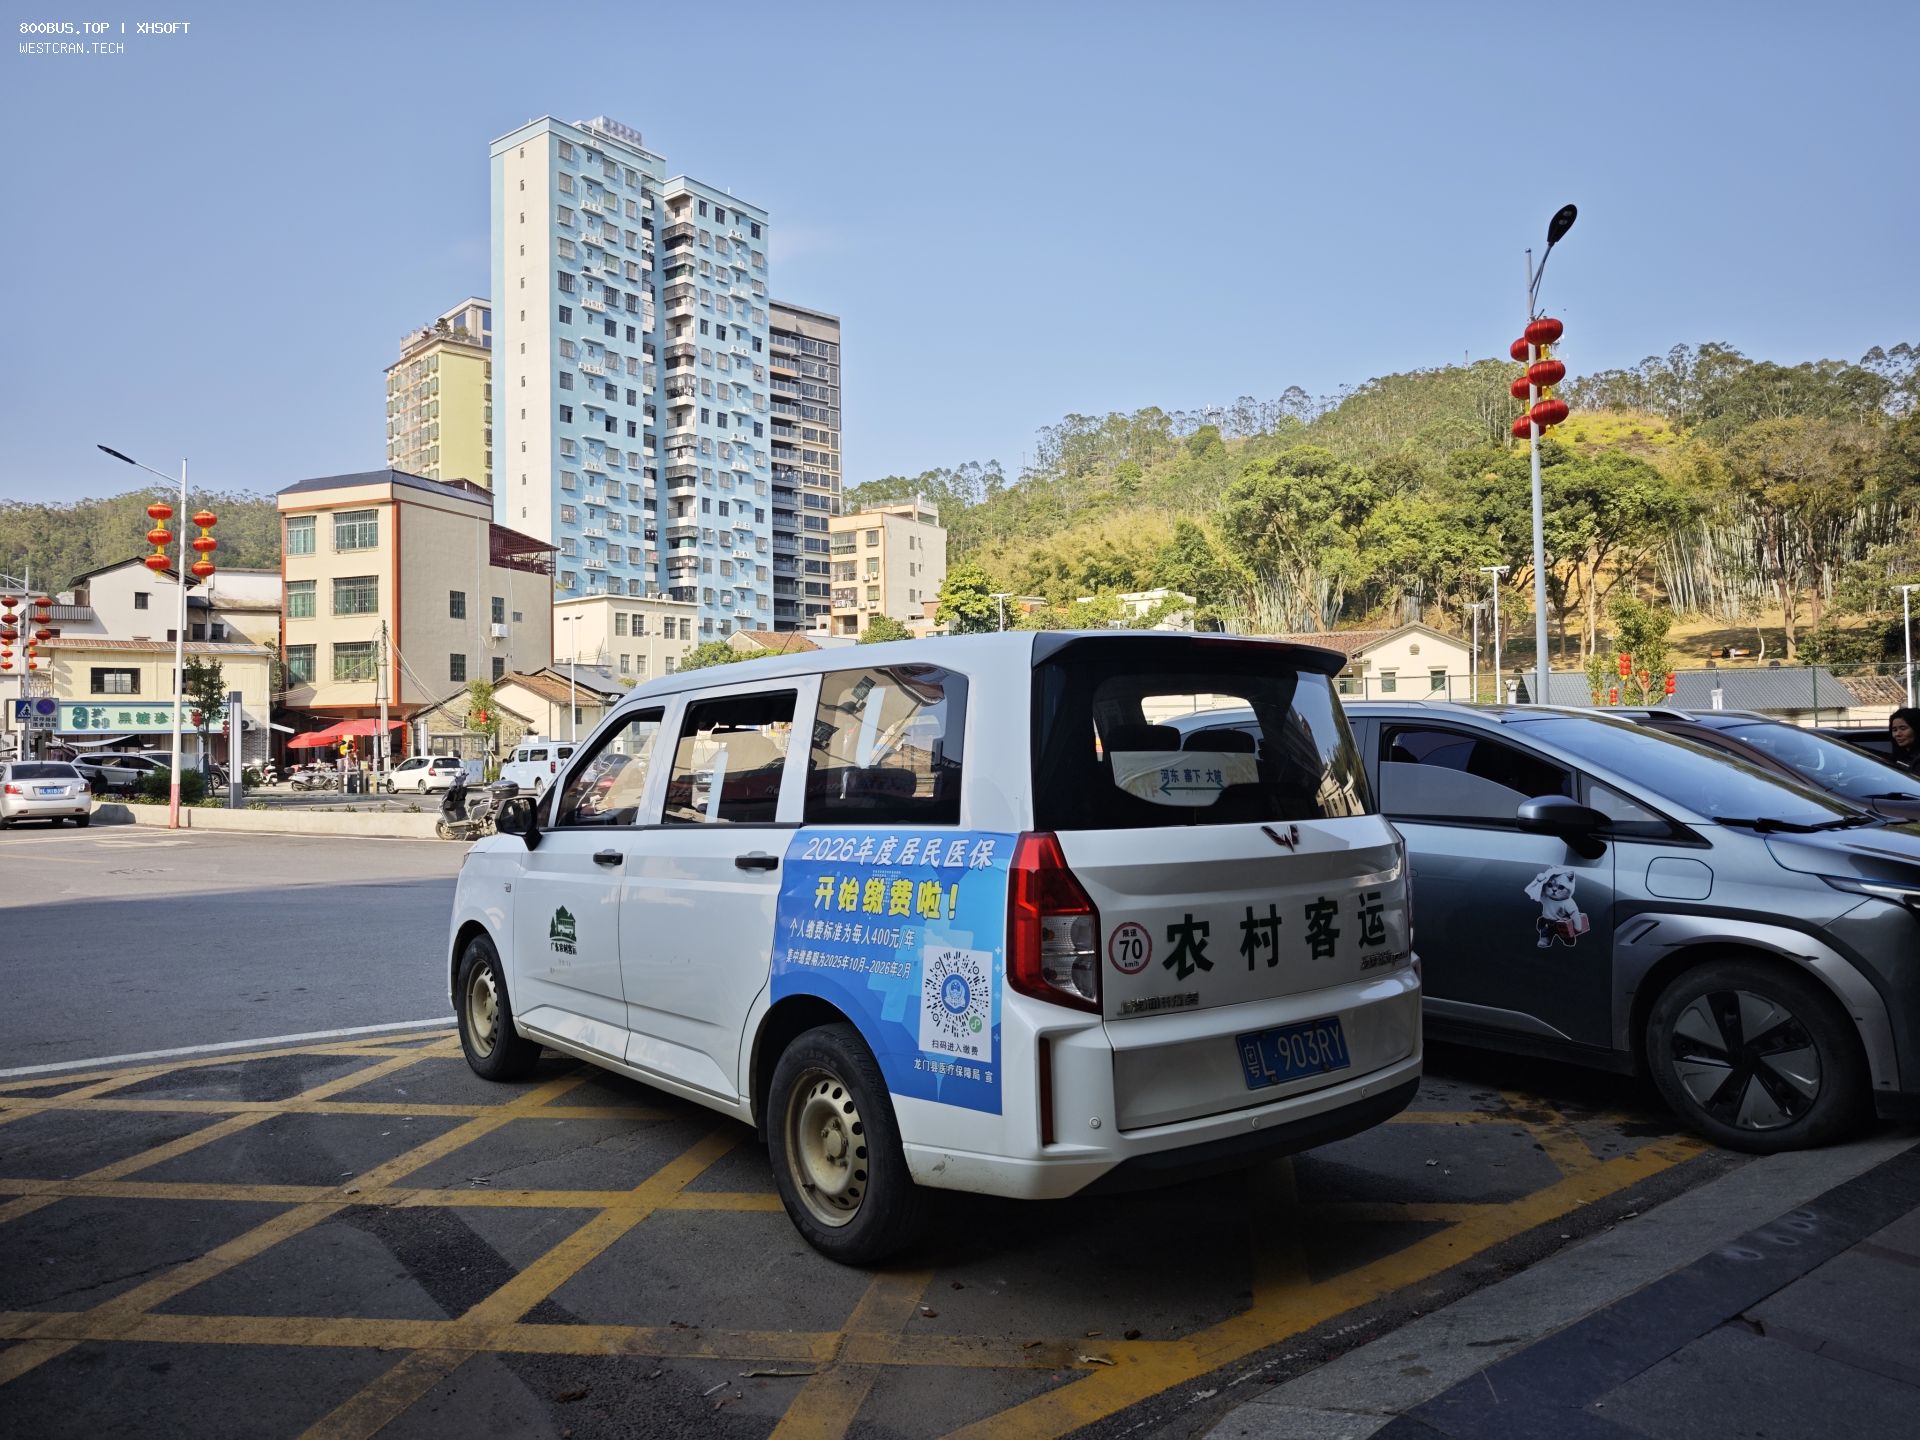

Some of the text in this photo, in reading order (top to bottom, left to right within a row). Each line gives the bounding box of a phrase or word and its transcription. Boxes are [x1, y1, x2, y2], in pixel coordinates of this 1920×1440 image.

[802, 836, 996, 870] 2026年度居民医保
[789, 918, 915, 950] 个人缴费标准为每人400元/年
[1122, 928, 1138, 937] 限速
[1162, 891, 1387, 981] 农村客运
[1119, 939, 1143, 961] 70
[1124, 960, 1140, 968] km/h
[931, 1040, 979, 1056] 扫码进入缴费
[914, 1057, 993, 1084] 龙门县医疗保障局 宣
